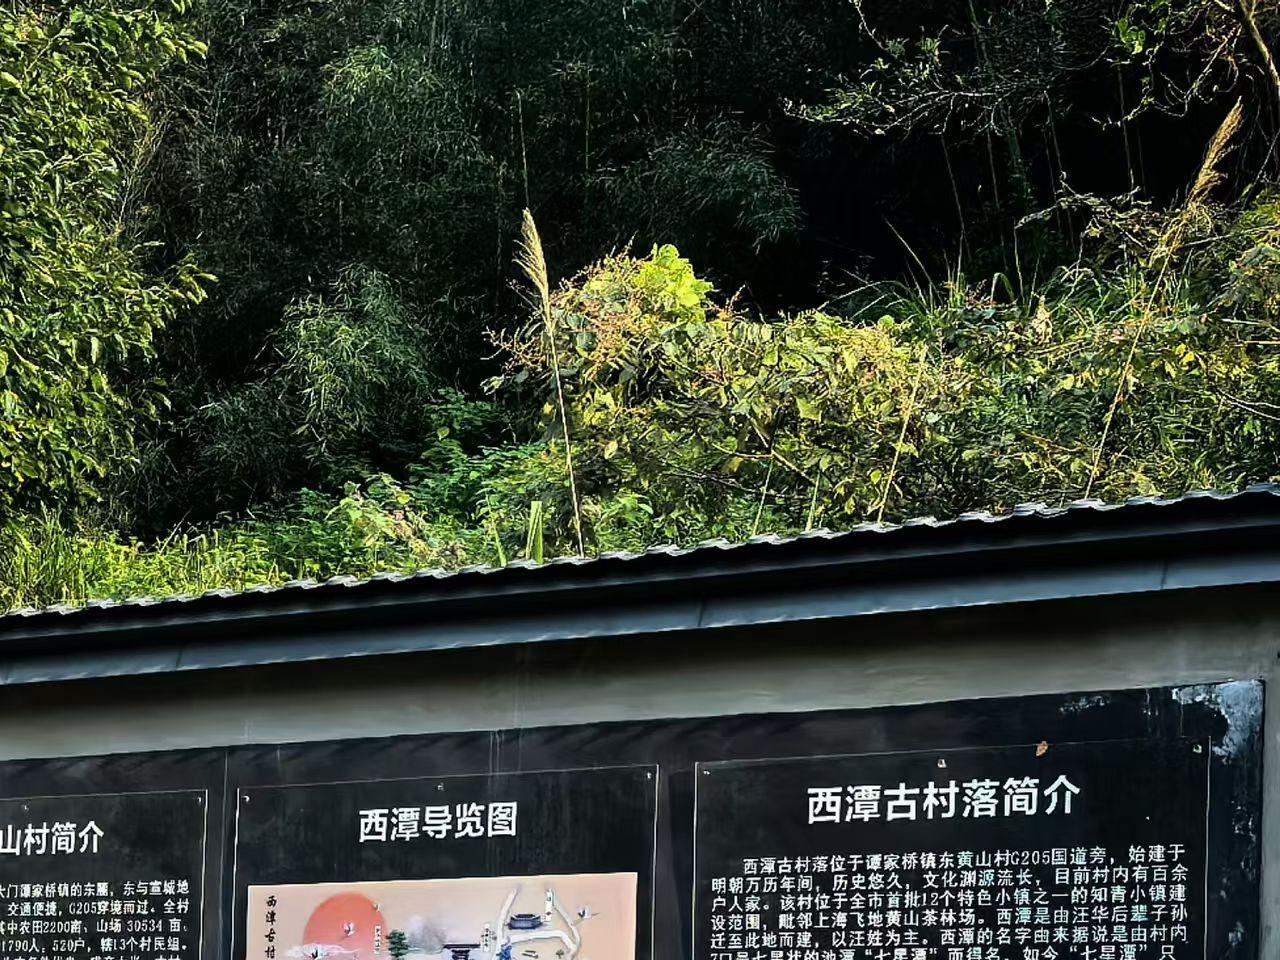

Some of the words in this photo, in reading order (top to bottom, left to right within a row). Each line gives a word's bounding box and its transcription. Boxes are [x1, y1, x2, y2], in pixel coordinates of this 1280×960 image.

[358, 801, 518, 843] 西潭导览图
[807, 775, 1081, 824] 西潭古村落简介
